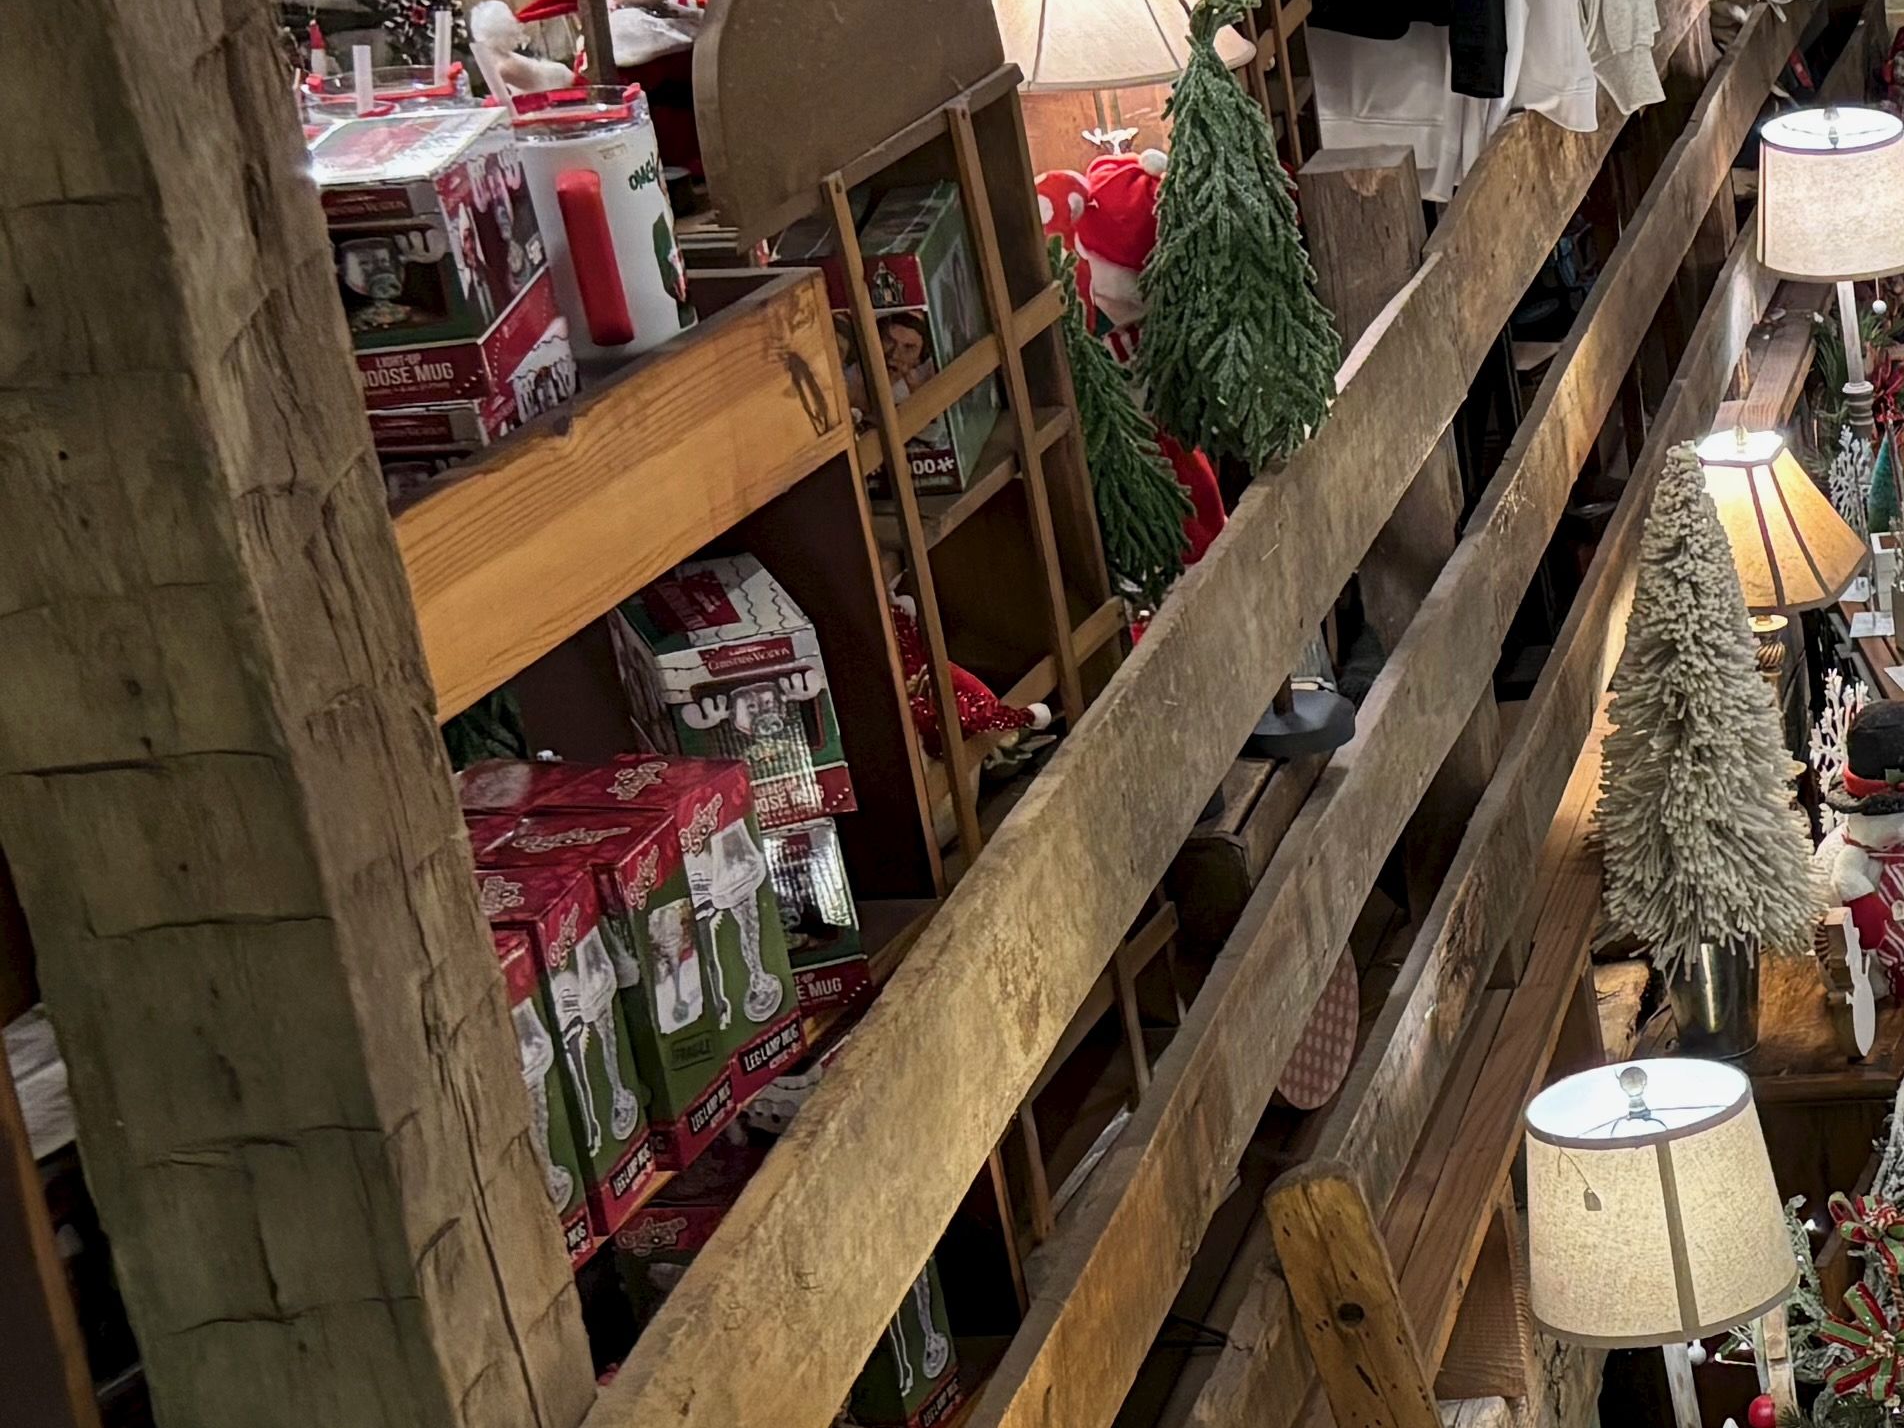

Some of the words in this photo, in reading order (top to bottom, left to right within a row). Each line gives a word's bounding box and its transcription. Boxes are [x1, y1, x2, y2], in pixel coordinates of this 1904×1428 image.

[365, 368, 413, 388] OOSE
[414, 362, 454, 383] MUG
[912, 458, 935, 475] 00
[809, 977, 842, 998] MUG
